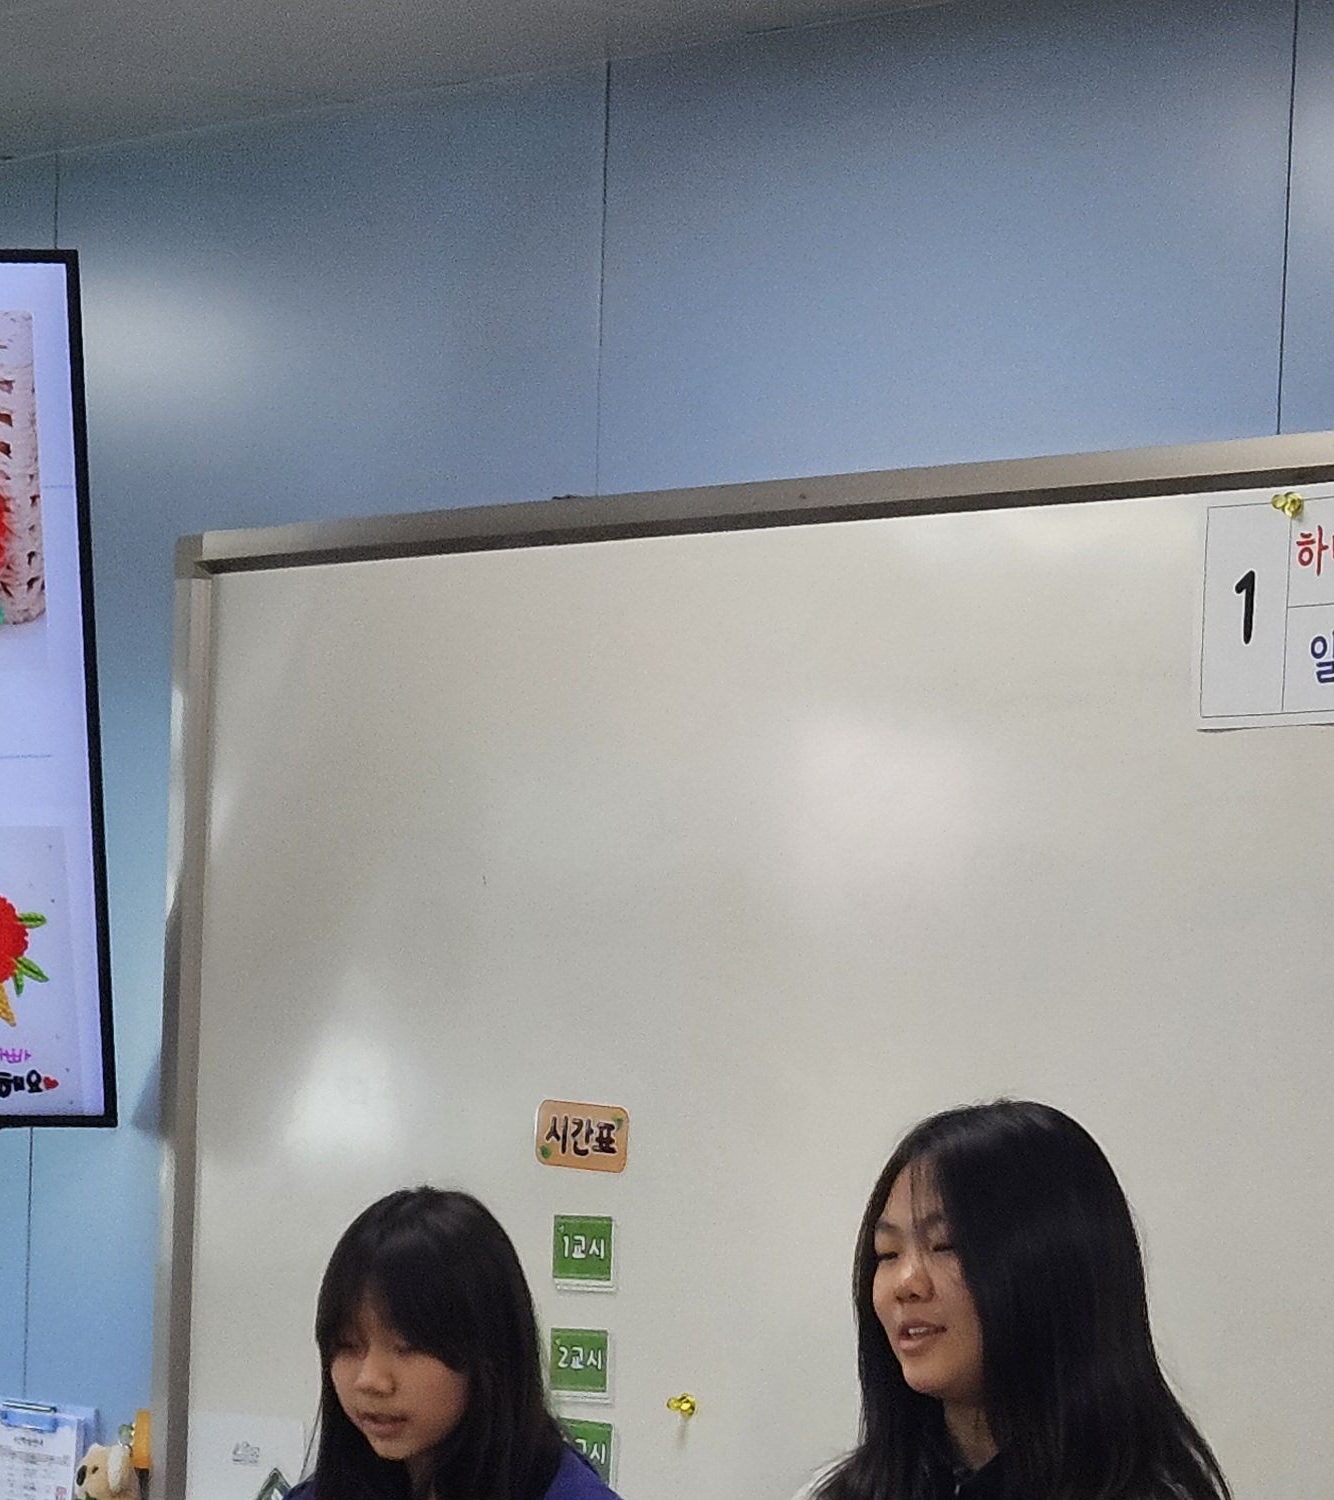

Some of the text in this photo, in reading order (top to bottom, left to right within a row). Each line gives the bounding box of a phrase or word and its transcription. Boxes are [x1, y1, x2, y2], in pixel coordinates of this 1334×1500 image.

[1234, 570, 1256, 644] 1
[545, 1116, 617, 1156] 시간표
[563, 1235, 605, 1259] 1교시
[557, 1347, 602, 1370] 2교시
